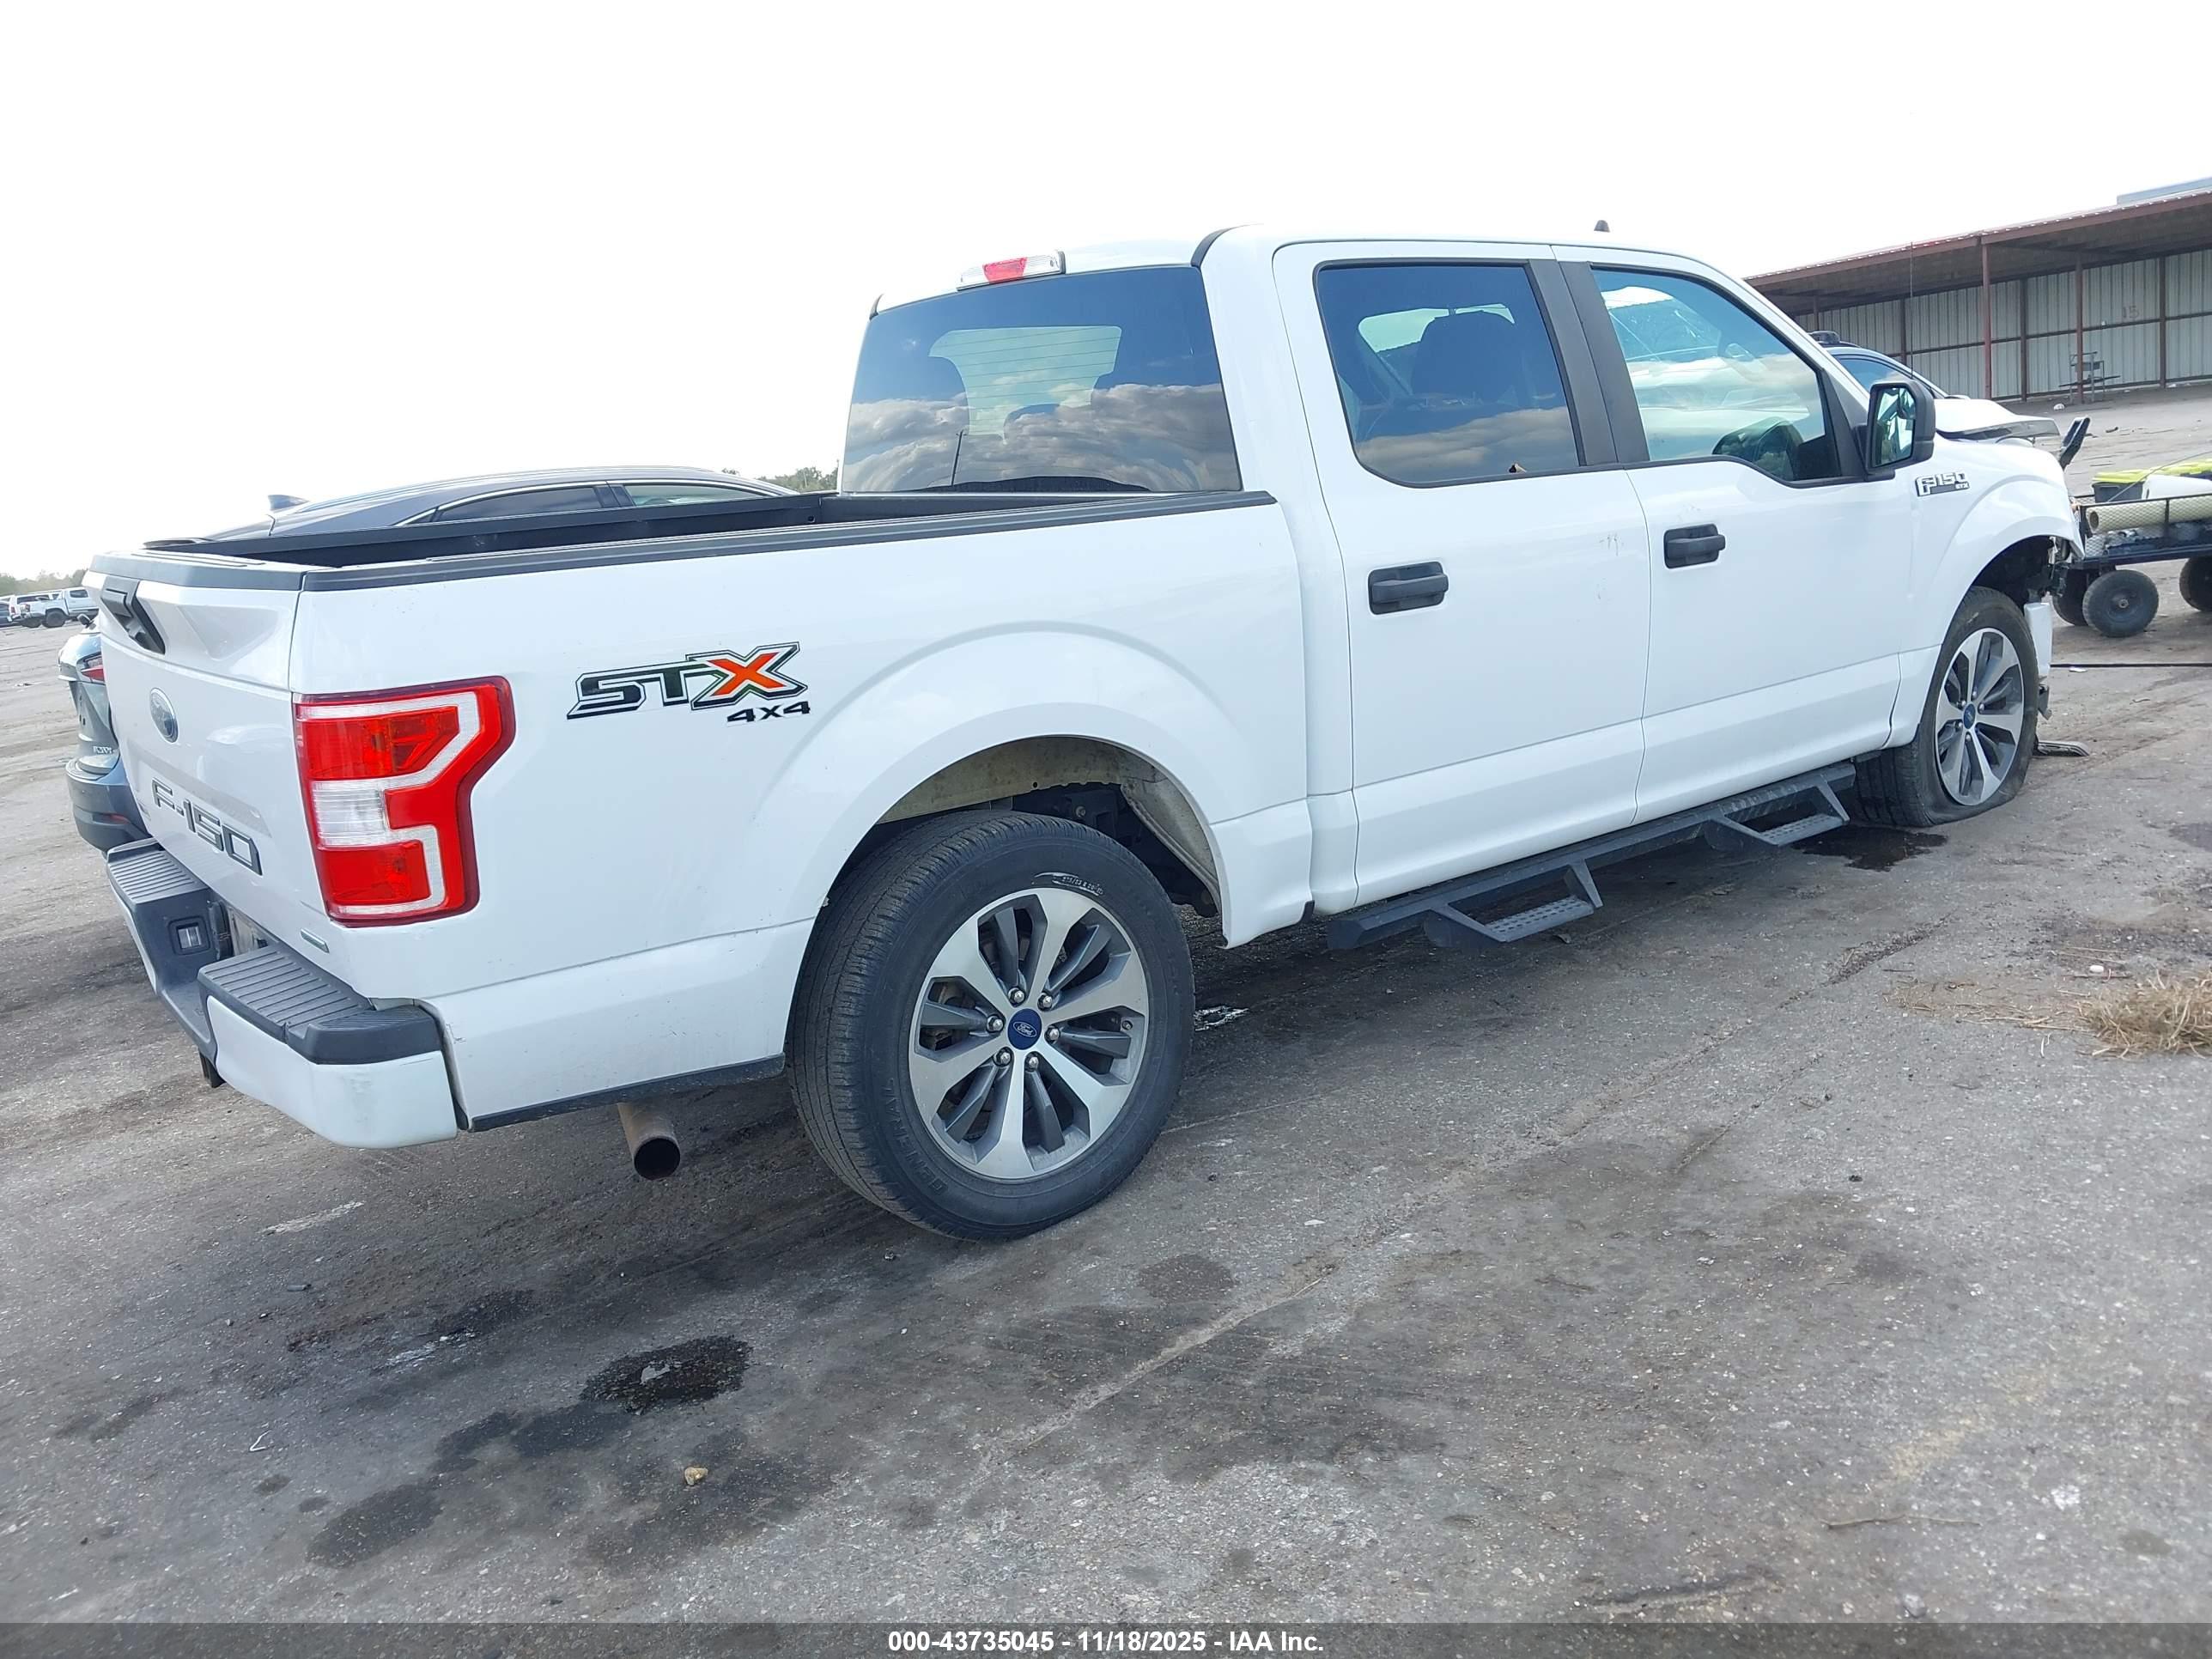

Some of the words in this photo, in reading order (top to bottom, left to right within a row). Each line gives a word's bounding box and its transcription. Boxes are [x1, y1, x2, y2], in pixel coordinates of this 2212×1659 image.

[1915, 472, 1968, 496] F150
[567, 641, 808, 720] STX
[152, 777, 263, 876] F-150
